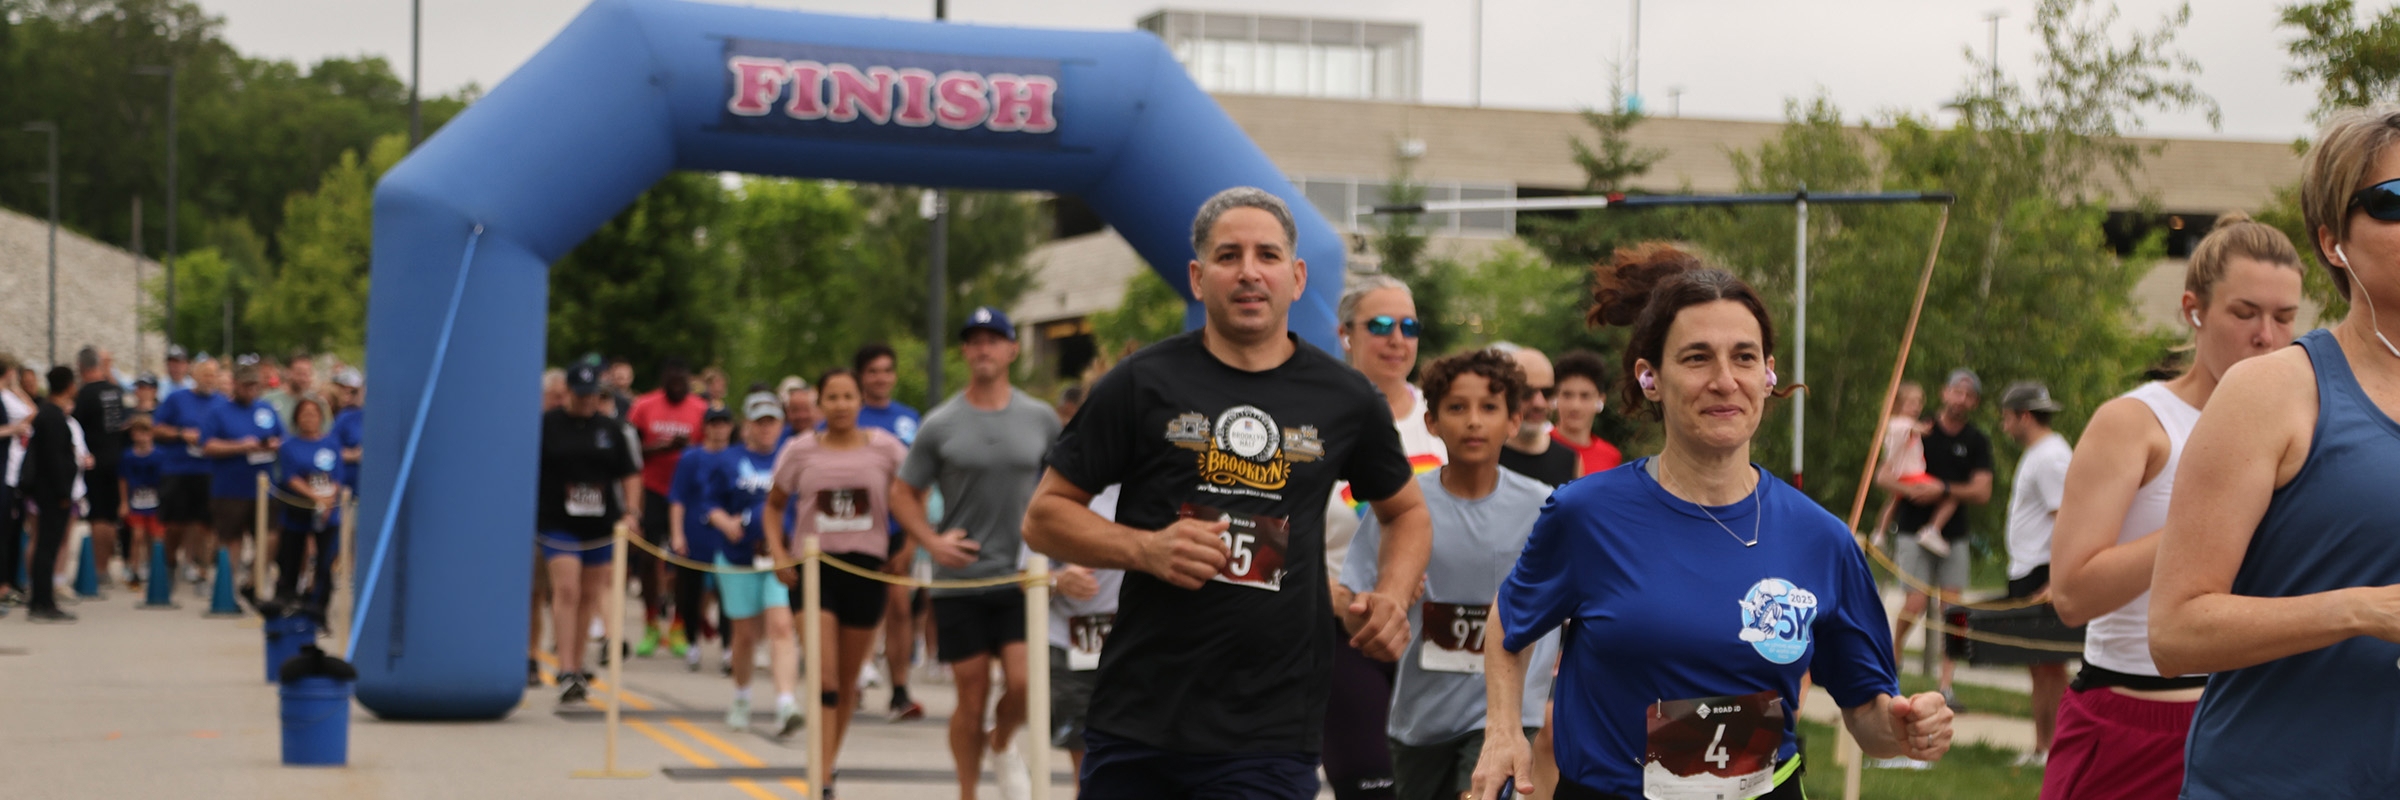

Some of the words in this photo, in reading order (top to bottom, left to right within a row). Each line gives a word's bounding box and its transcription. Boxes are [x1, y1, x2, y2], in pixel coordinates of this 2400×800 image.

[728, 56, 1057, 133] FINISH
[1232, 431, 1266, 441] BROOKLYN
[1240, 439, 1255, 447] HALF
[1207, 450, 1284, 483] BROOKLYN
[1790, 593, 1813, 605] 2025
[1454, 619, 1486, 650] 97
[1713, 706, 1733, 714] ROAD
[1704, 723, 1729, 769] 4
